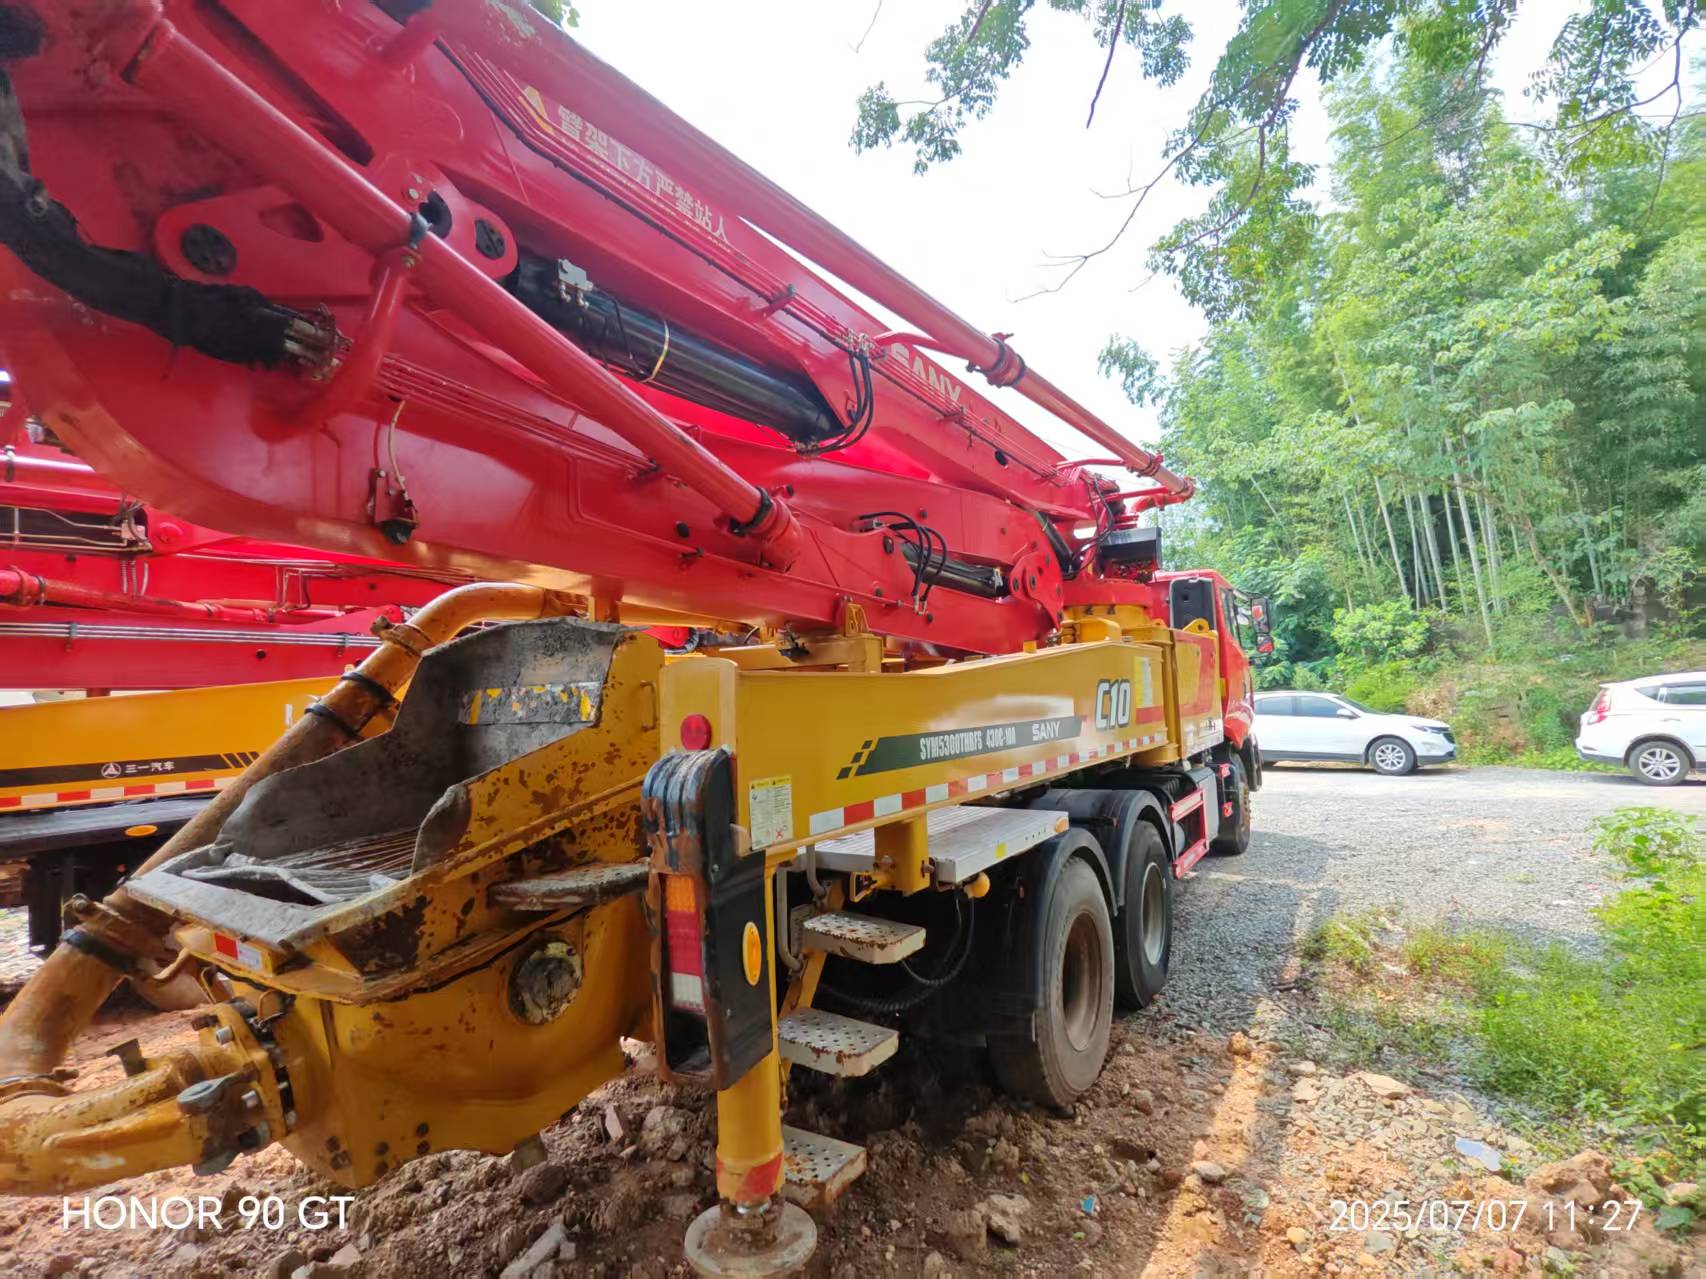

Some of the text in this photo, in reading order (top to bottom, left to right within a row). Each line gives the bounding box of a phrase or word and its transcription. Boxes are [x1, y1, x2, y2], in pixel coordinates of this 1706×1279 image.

[890, 342, 962, 402] SANY
[1095, 678, 1132, 731] C10
[1031, 720, 1060, 741] SANY
[125, 761, 175, 773] 三一汽车
